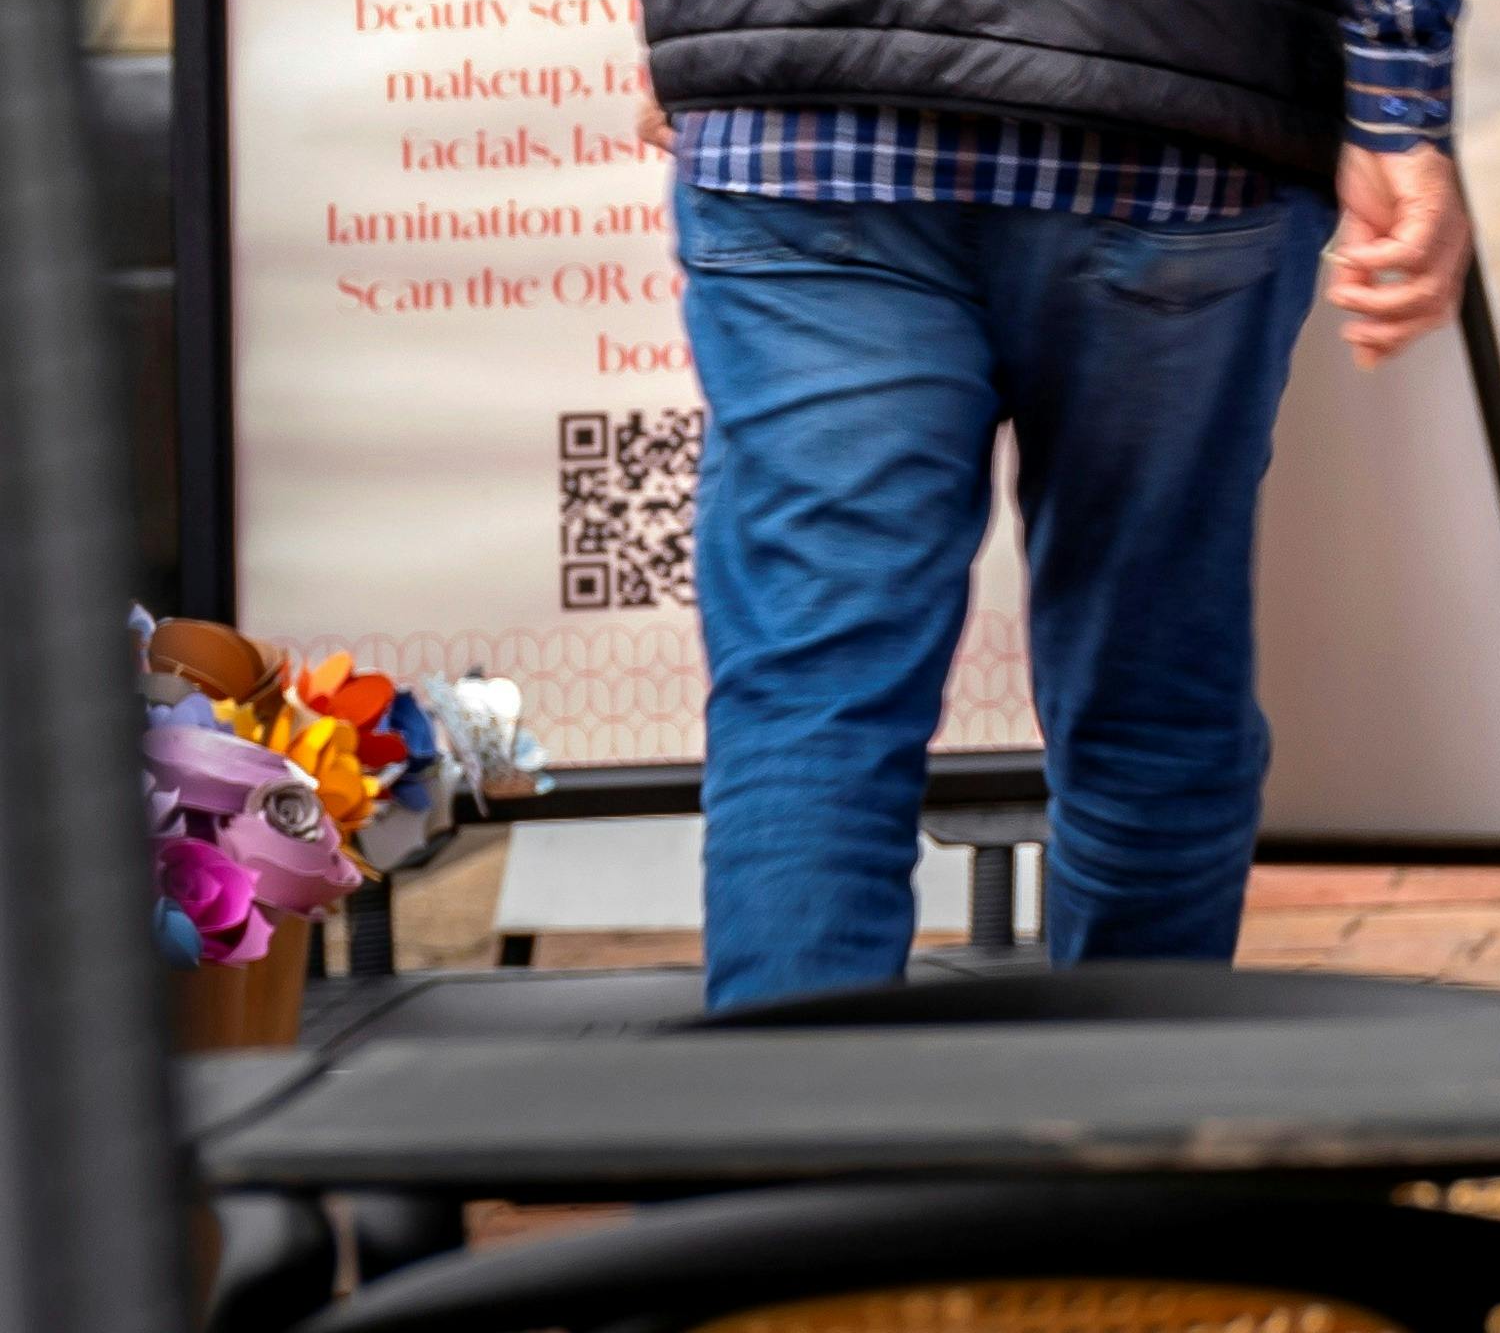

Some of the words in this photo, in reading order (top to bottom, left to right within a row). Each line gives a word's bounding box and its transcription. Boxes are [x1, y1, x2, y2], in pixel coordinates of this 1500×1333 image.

[385, 59, 593, 106] makeup,
[326, 197, 583, 245] lamination
[335, 270, 453, 315] Scan
[466, 265, 541, 309] the
